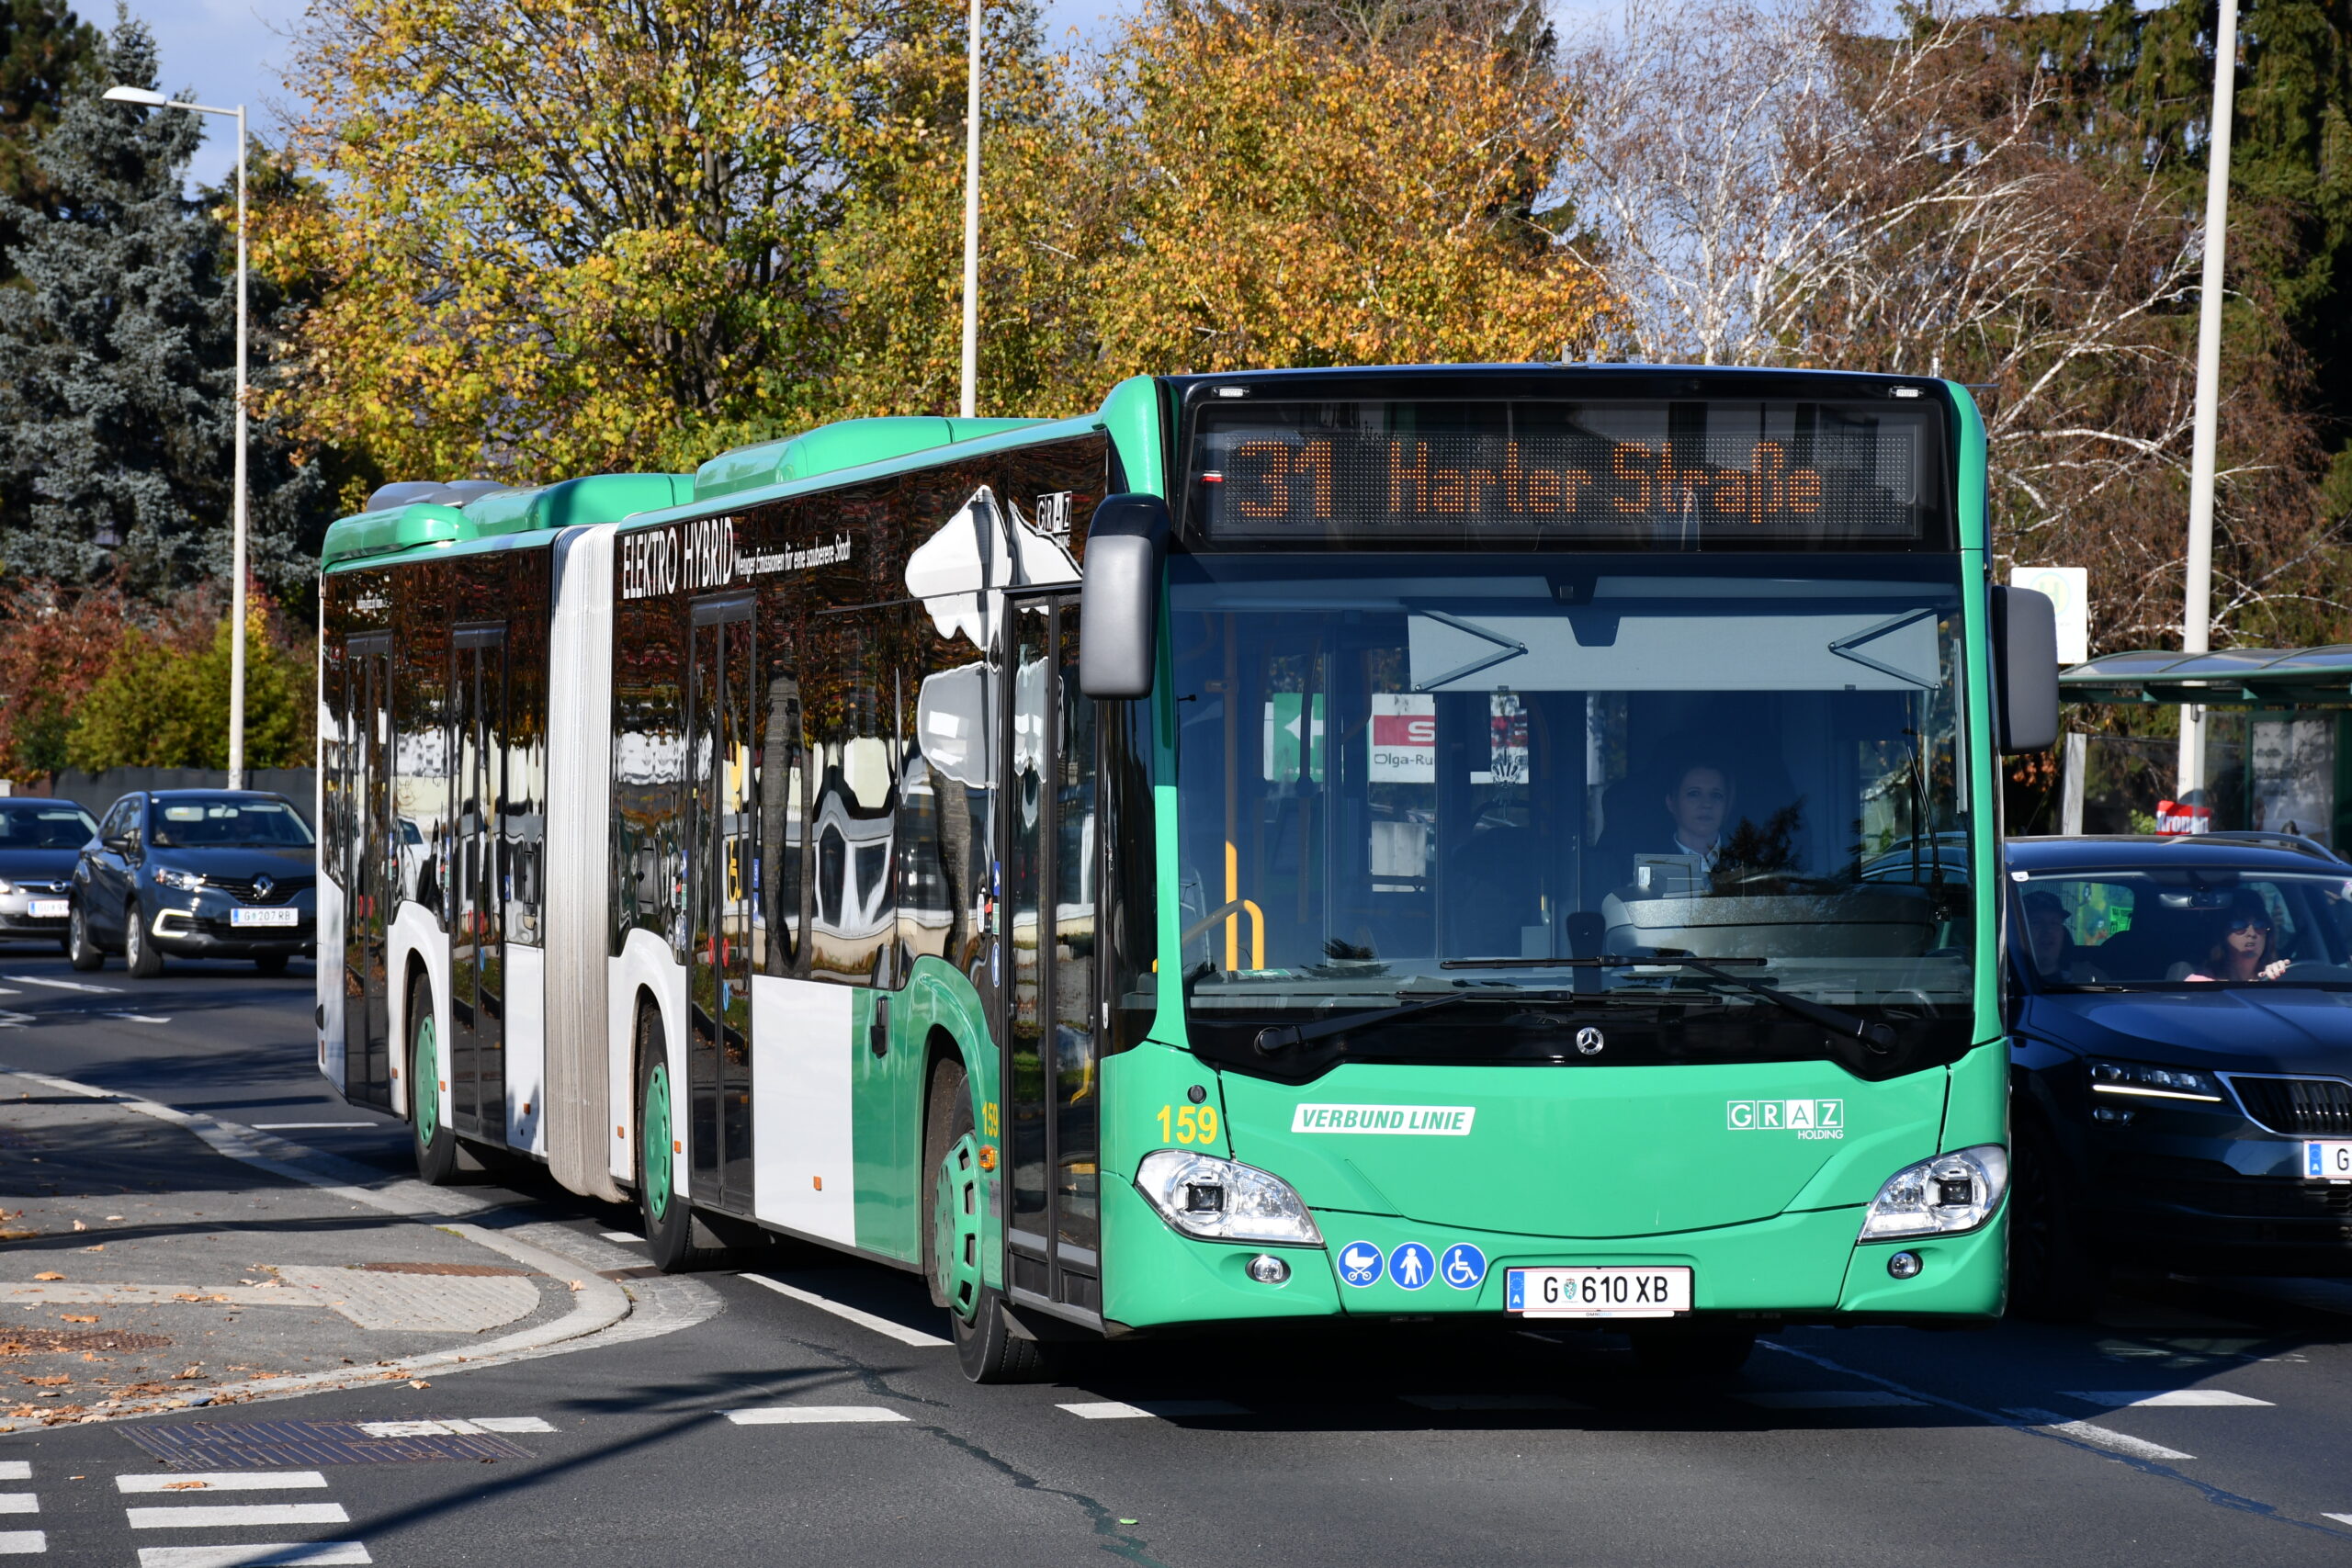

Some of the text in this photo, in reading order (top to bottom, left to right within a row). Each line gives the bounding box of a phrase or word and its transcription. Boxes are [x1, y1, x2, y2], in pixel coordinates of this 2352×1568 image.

[1240, 440, 1822, 524] 31 Harter Straße
[1037, 494, 1070, 533] GRAZ
[623, 516, 733, 600] ELEKTRO HYBRID
[735, 549, 755, 583] Weniger
[756, 547, 785, 573] Emissionen
[794, 542, 806, 570] eine
[807, 536, 834, 568] sauberere
[835, 529, 851, 562] Stadt
[2156, 811, 2209, 834] Kronen
[244, 910, 251, 920] G
[258, 910, 276, 920] 207
[982, 1100, 999, 1139] 159
[1157, 1105, 1218, 1145] 159
[1303, 1109, 1465, 1130] VERBUND LINIE
[1730, 1101, 1839, 1128] GRAZ
[1797, 1129, 1844, 1140] HOLDING
[2337, 1147, 2349, 1171] G
[1512, 1294, 1521, 1304] A
[1544, 1276, 1668, 1303] G 610 XB
